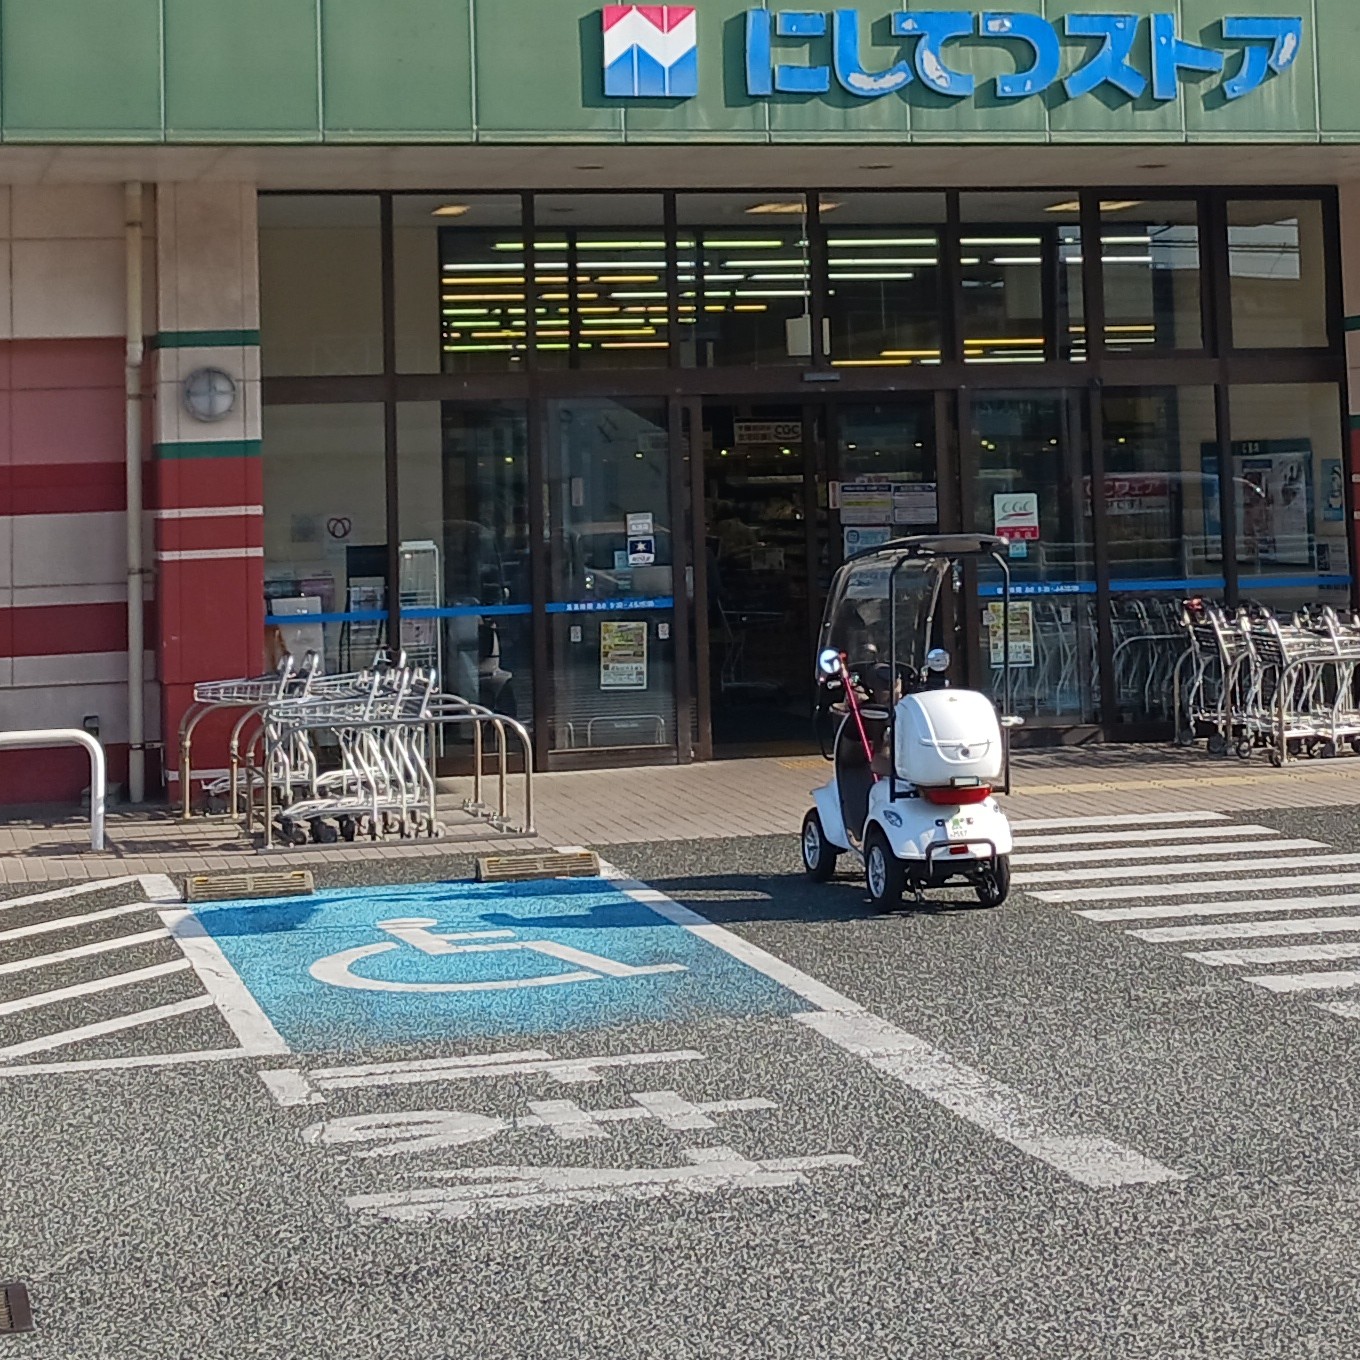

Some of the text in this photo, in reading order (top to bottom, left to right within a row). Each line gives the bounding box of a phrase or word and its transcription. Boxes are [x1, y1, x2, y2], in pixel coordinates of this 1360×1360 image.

[745, 8, 1302, 100] にしてつストア
